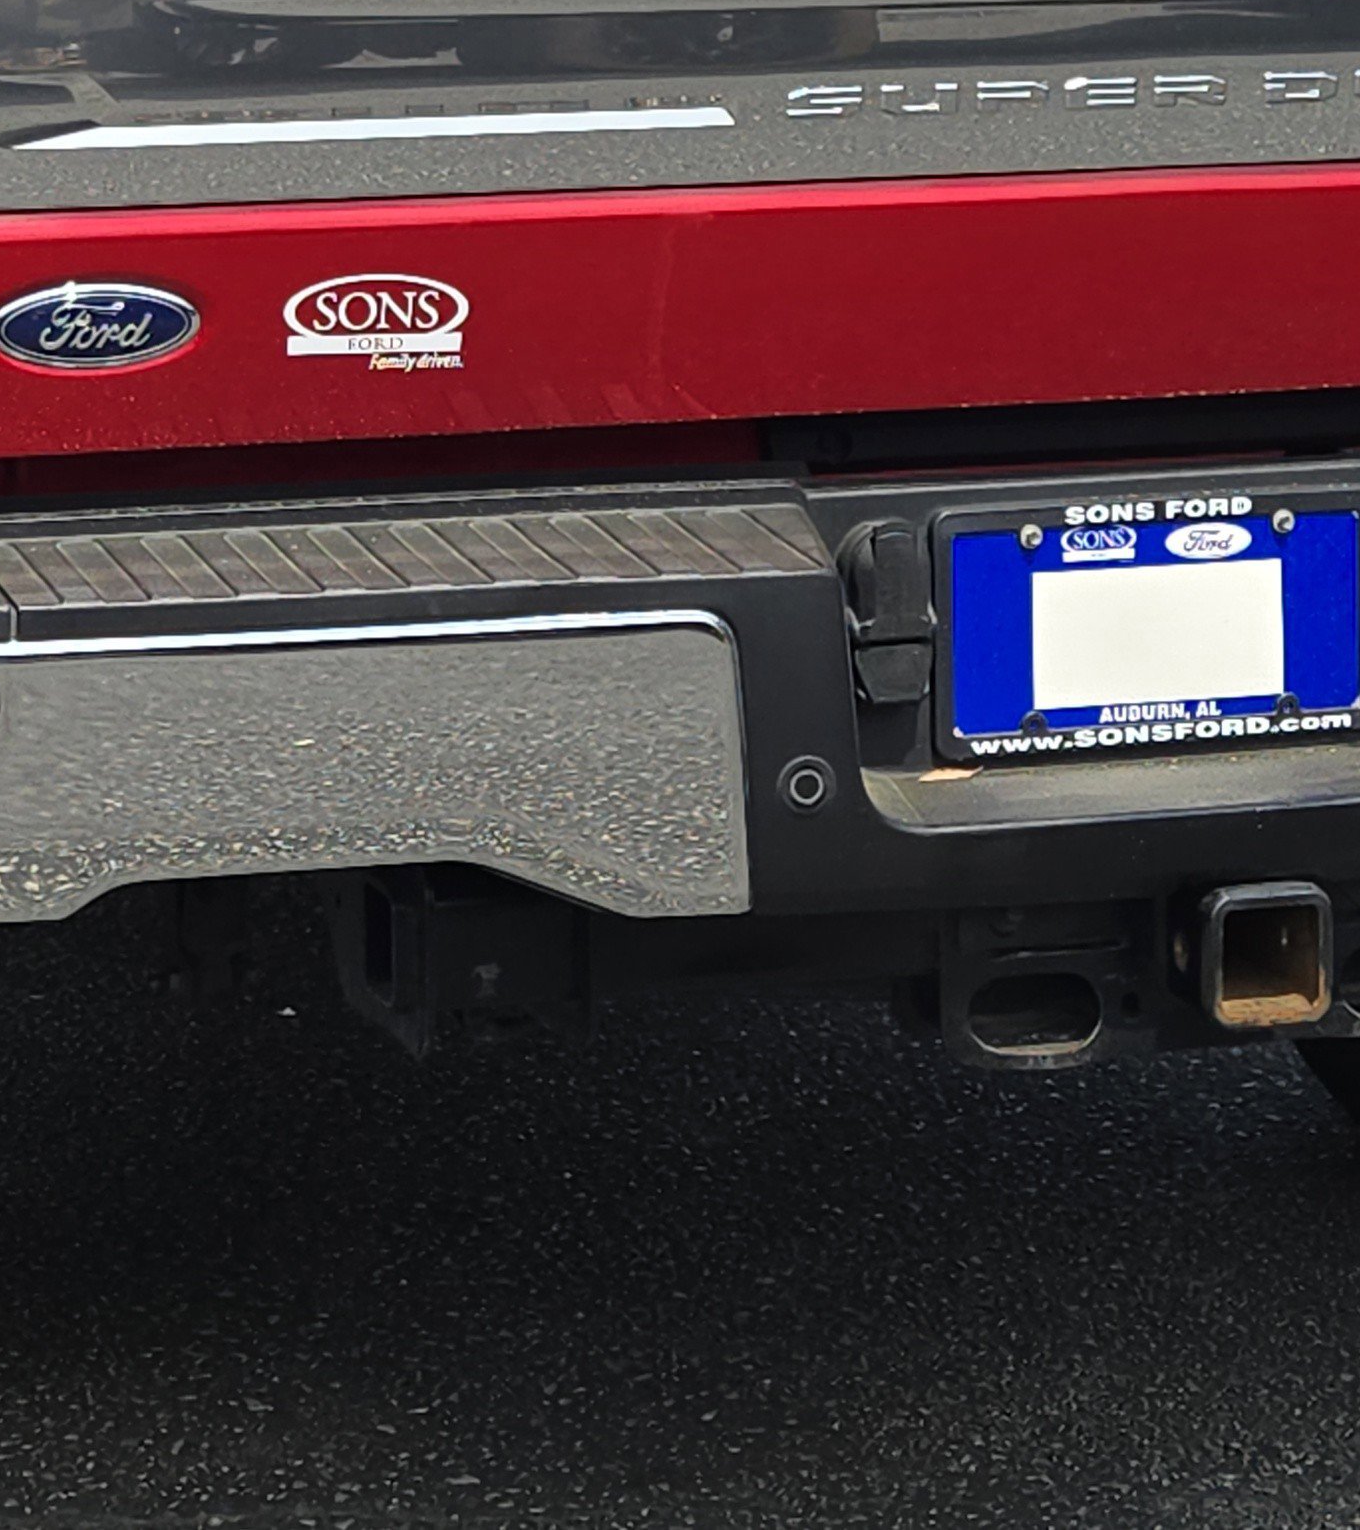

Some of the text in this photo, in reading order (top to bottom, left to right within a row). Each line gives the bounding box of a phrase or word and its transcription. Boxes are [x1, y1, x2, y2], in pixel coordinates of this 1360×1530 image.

[786, 76, 1227, 116] SUPER
[312, 290, 441, 331] SONS
[39, 301, 150, 350] Ford
[348, 337, 404, 351] FORD
[1064, 496, 1253, 525] SONS FORD
[1072, 530, 1127, 549] SONS
[1183, 530, 1234, 552] Ford
[1195, 701, 1222, 717] AL
[970, 712, 1352, 756] www.SONSFORD.com
